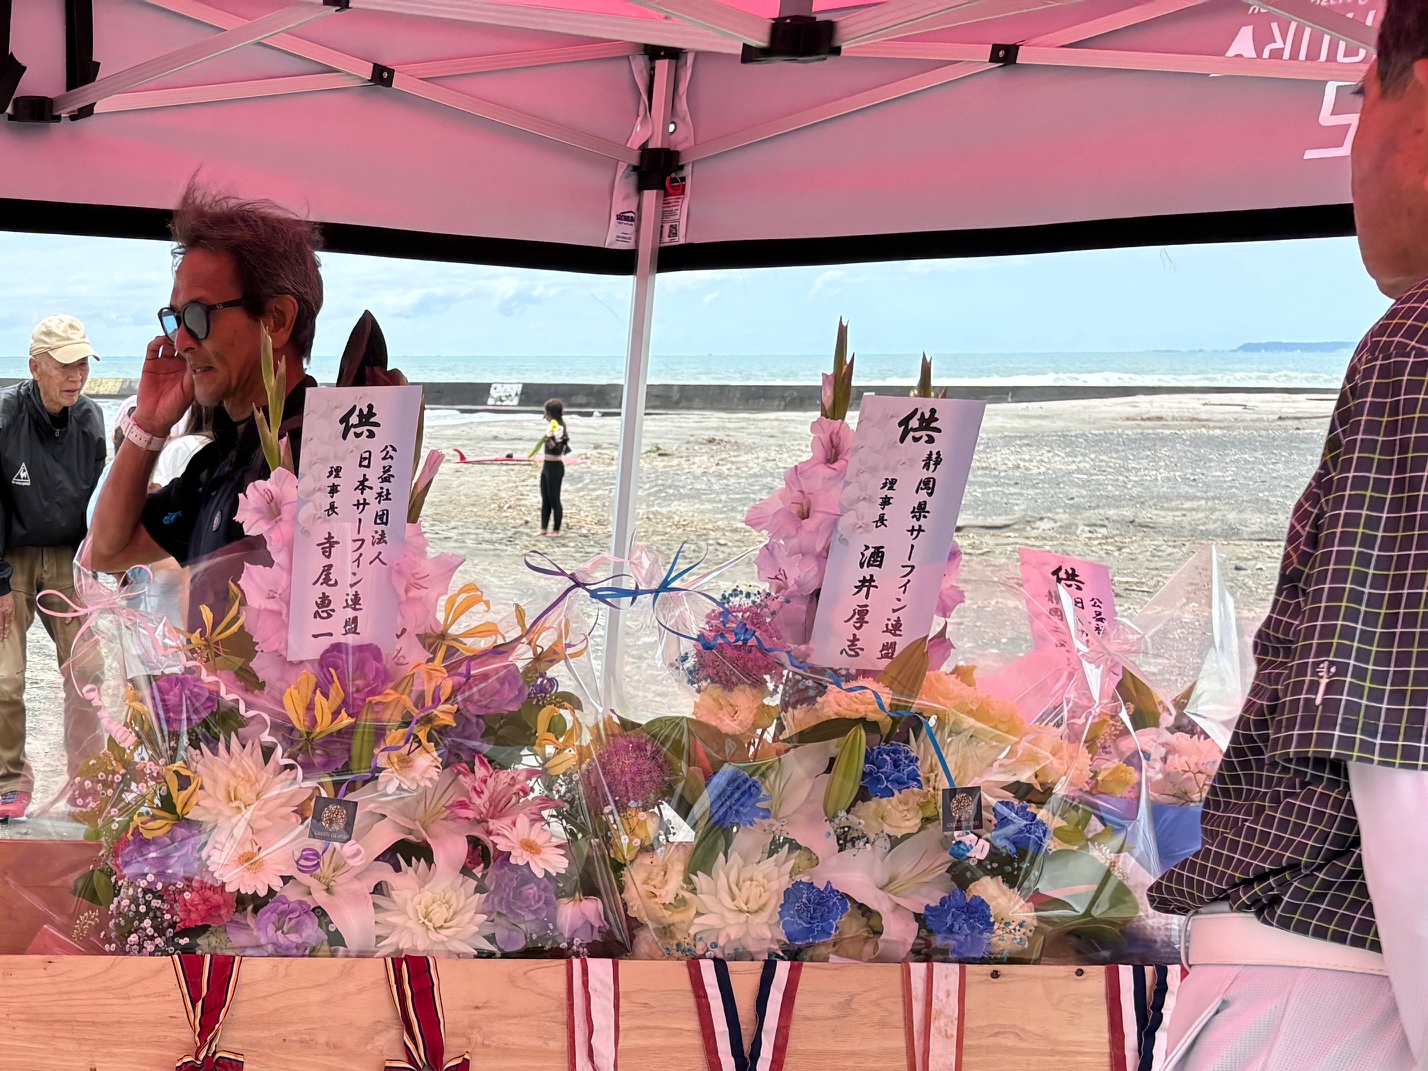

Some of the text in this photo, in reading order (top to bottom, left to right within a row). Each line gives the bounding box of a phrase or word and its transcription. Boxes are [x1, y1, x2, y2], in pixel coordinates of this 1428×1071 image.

[339, 403, 382, 441] 供
[368, 444, 398, 567] 公益社団法人
[897, 407, 942, 444] 供
[311, 465, 343, 639] 理事長 寺尾恵一
[341, 450, 374, 637] 日本サーフィン連盟
[839, 477, 898, 659] 理事長 酒井厚志
[876, 450, 943, 661] 静岡県サーフィン連盟
